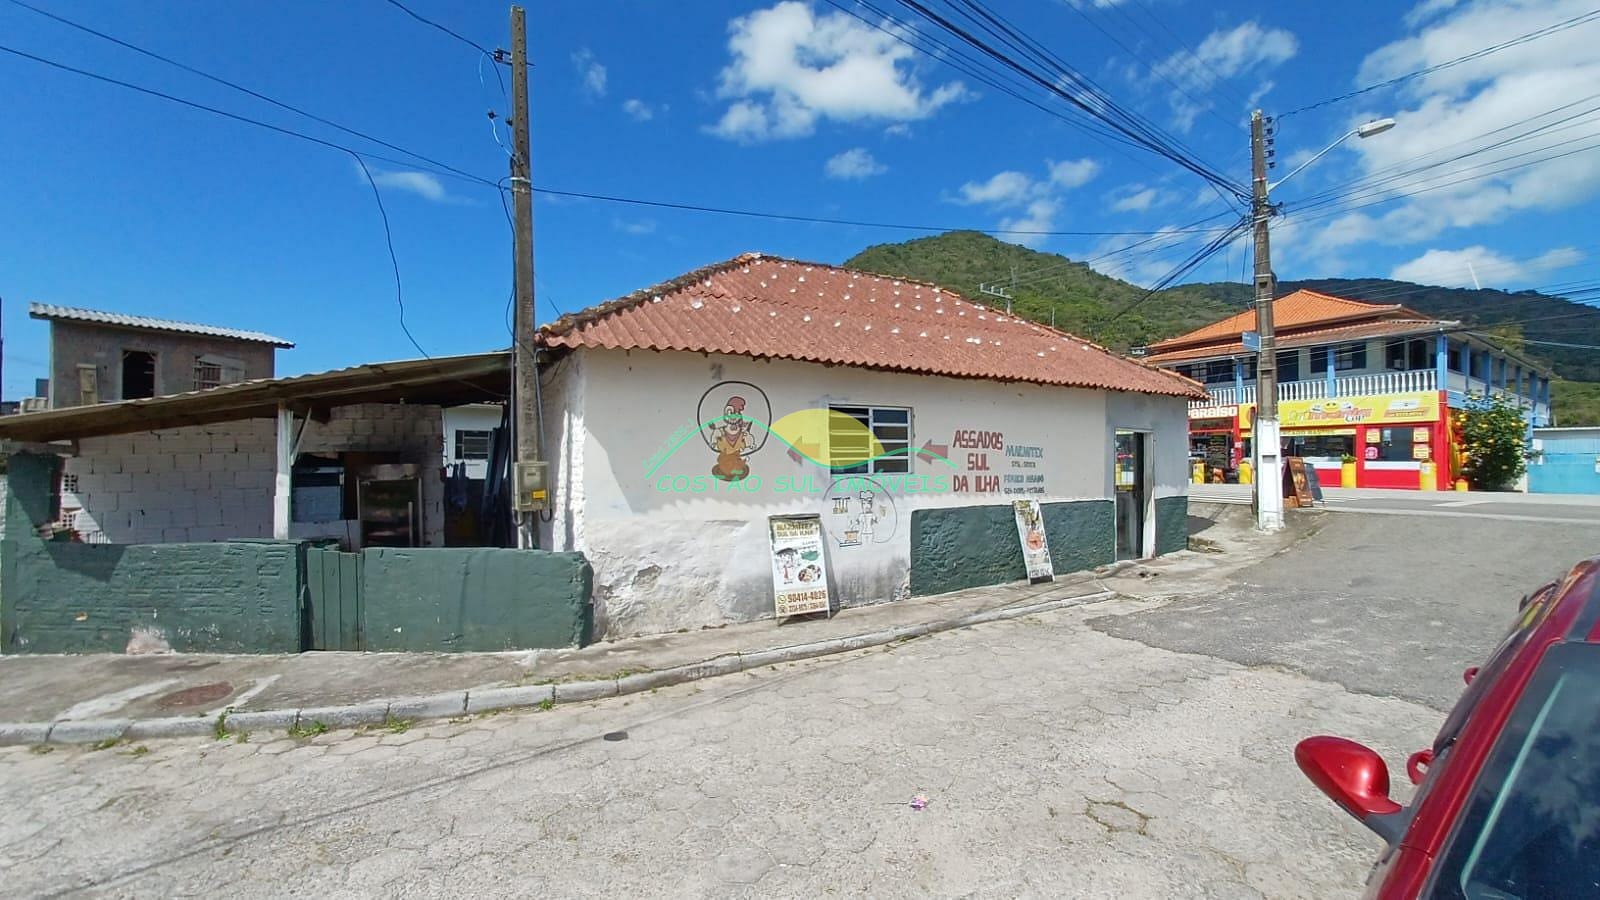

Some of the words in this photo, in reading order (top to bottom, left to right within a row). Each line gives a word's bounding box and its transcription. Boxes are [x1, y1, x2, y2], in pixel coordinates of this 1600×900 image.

[952, 430, 1004, 450] ASSADOS
[967, 452, 990, 471] SUL
[953, 475, 968, 493] DA
[975, 475, 1000, 493] ILHA
